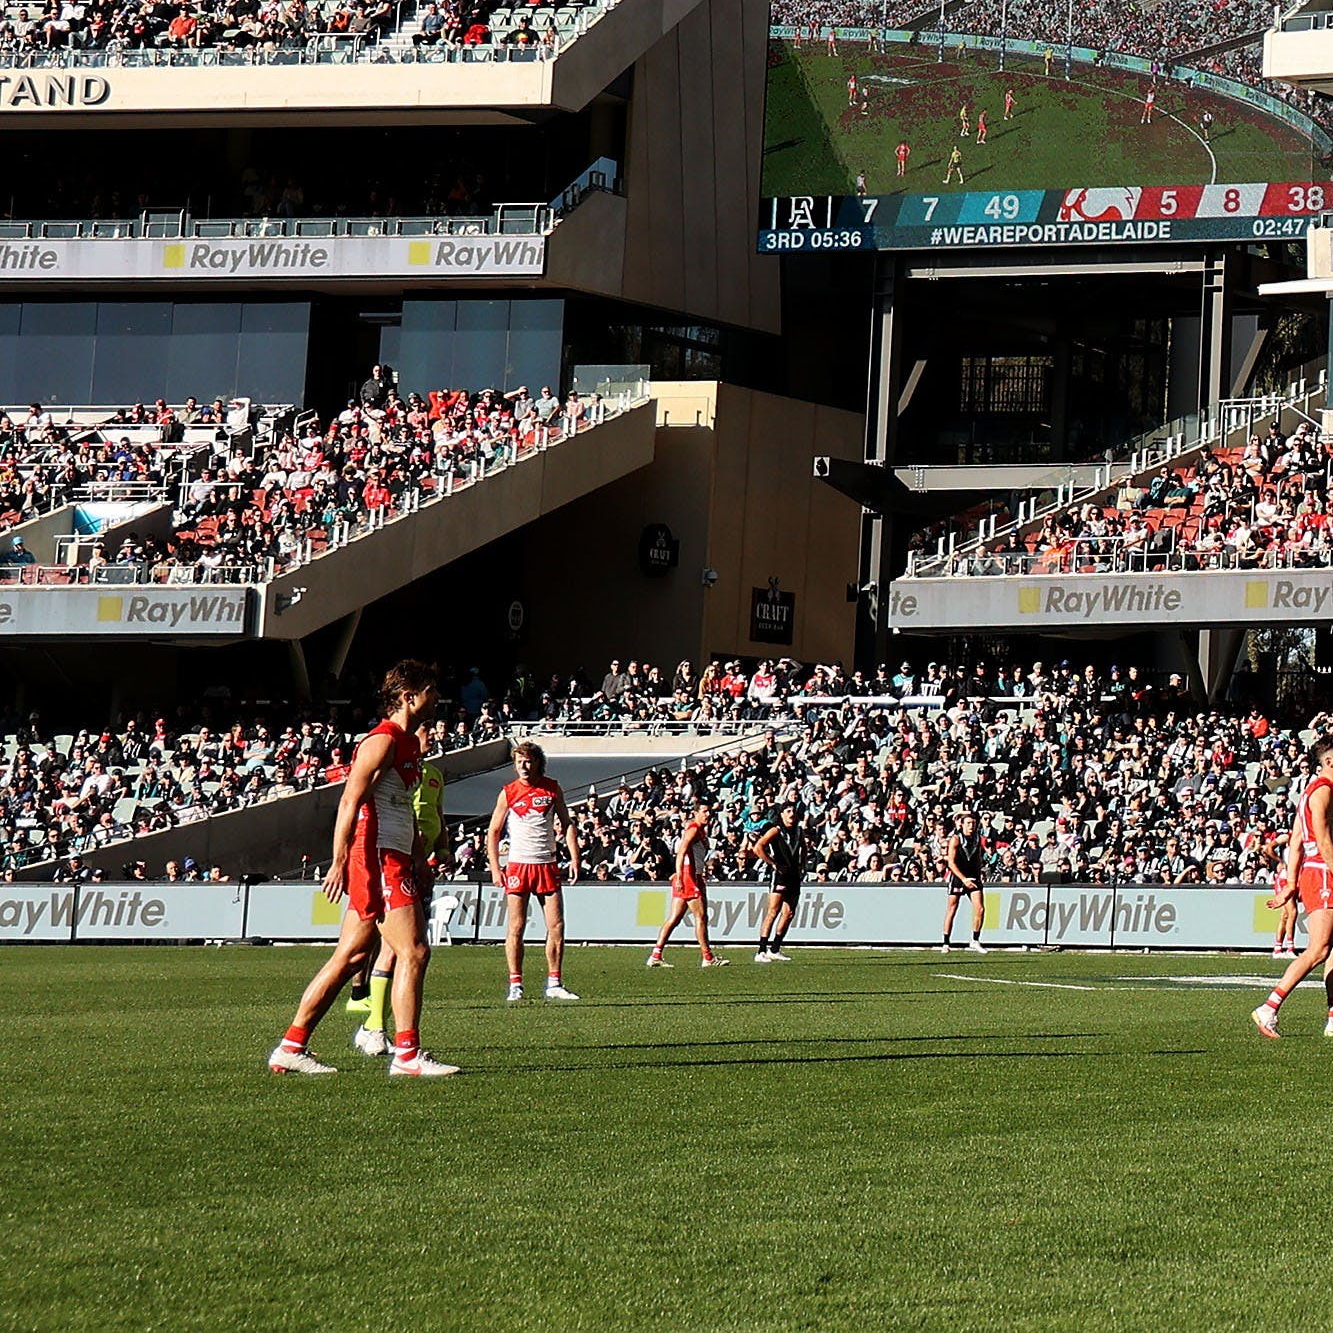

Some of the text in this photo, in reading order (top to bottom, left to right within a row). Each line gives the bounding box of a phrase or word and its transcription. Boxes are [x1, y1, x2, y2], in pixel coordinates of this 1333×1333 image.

[861, 198, 878, 224] 7
[922, 197, 939, 222] 7
[983, 195, 1020, 219] 49
[1160, 191, 1177, 215] 5
[1223, 188, 1240, 212] 8
[1287, 186, 1325, 211] 38
[766, 230, 862, 249] 3RD 05:36
[930, 219, 1303, 245] #WEAREPORTADELAIDE 02:47
[0, 244, 57, 270] hite
[191, 244, 329, 275] RayWhite
[1044, 585, 1182, 616] RayWhite
[682, 892, 844, 936] ayWite
[1006, 892, 1177, 939] RayWhite
